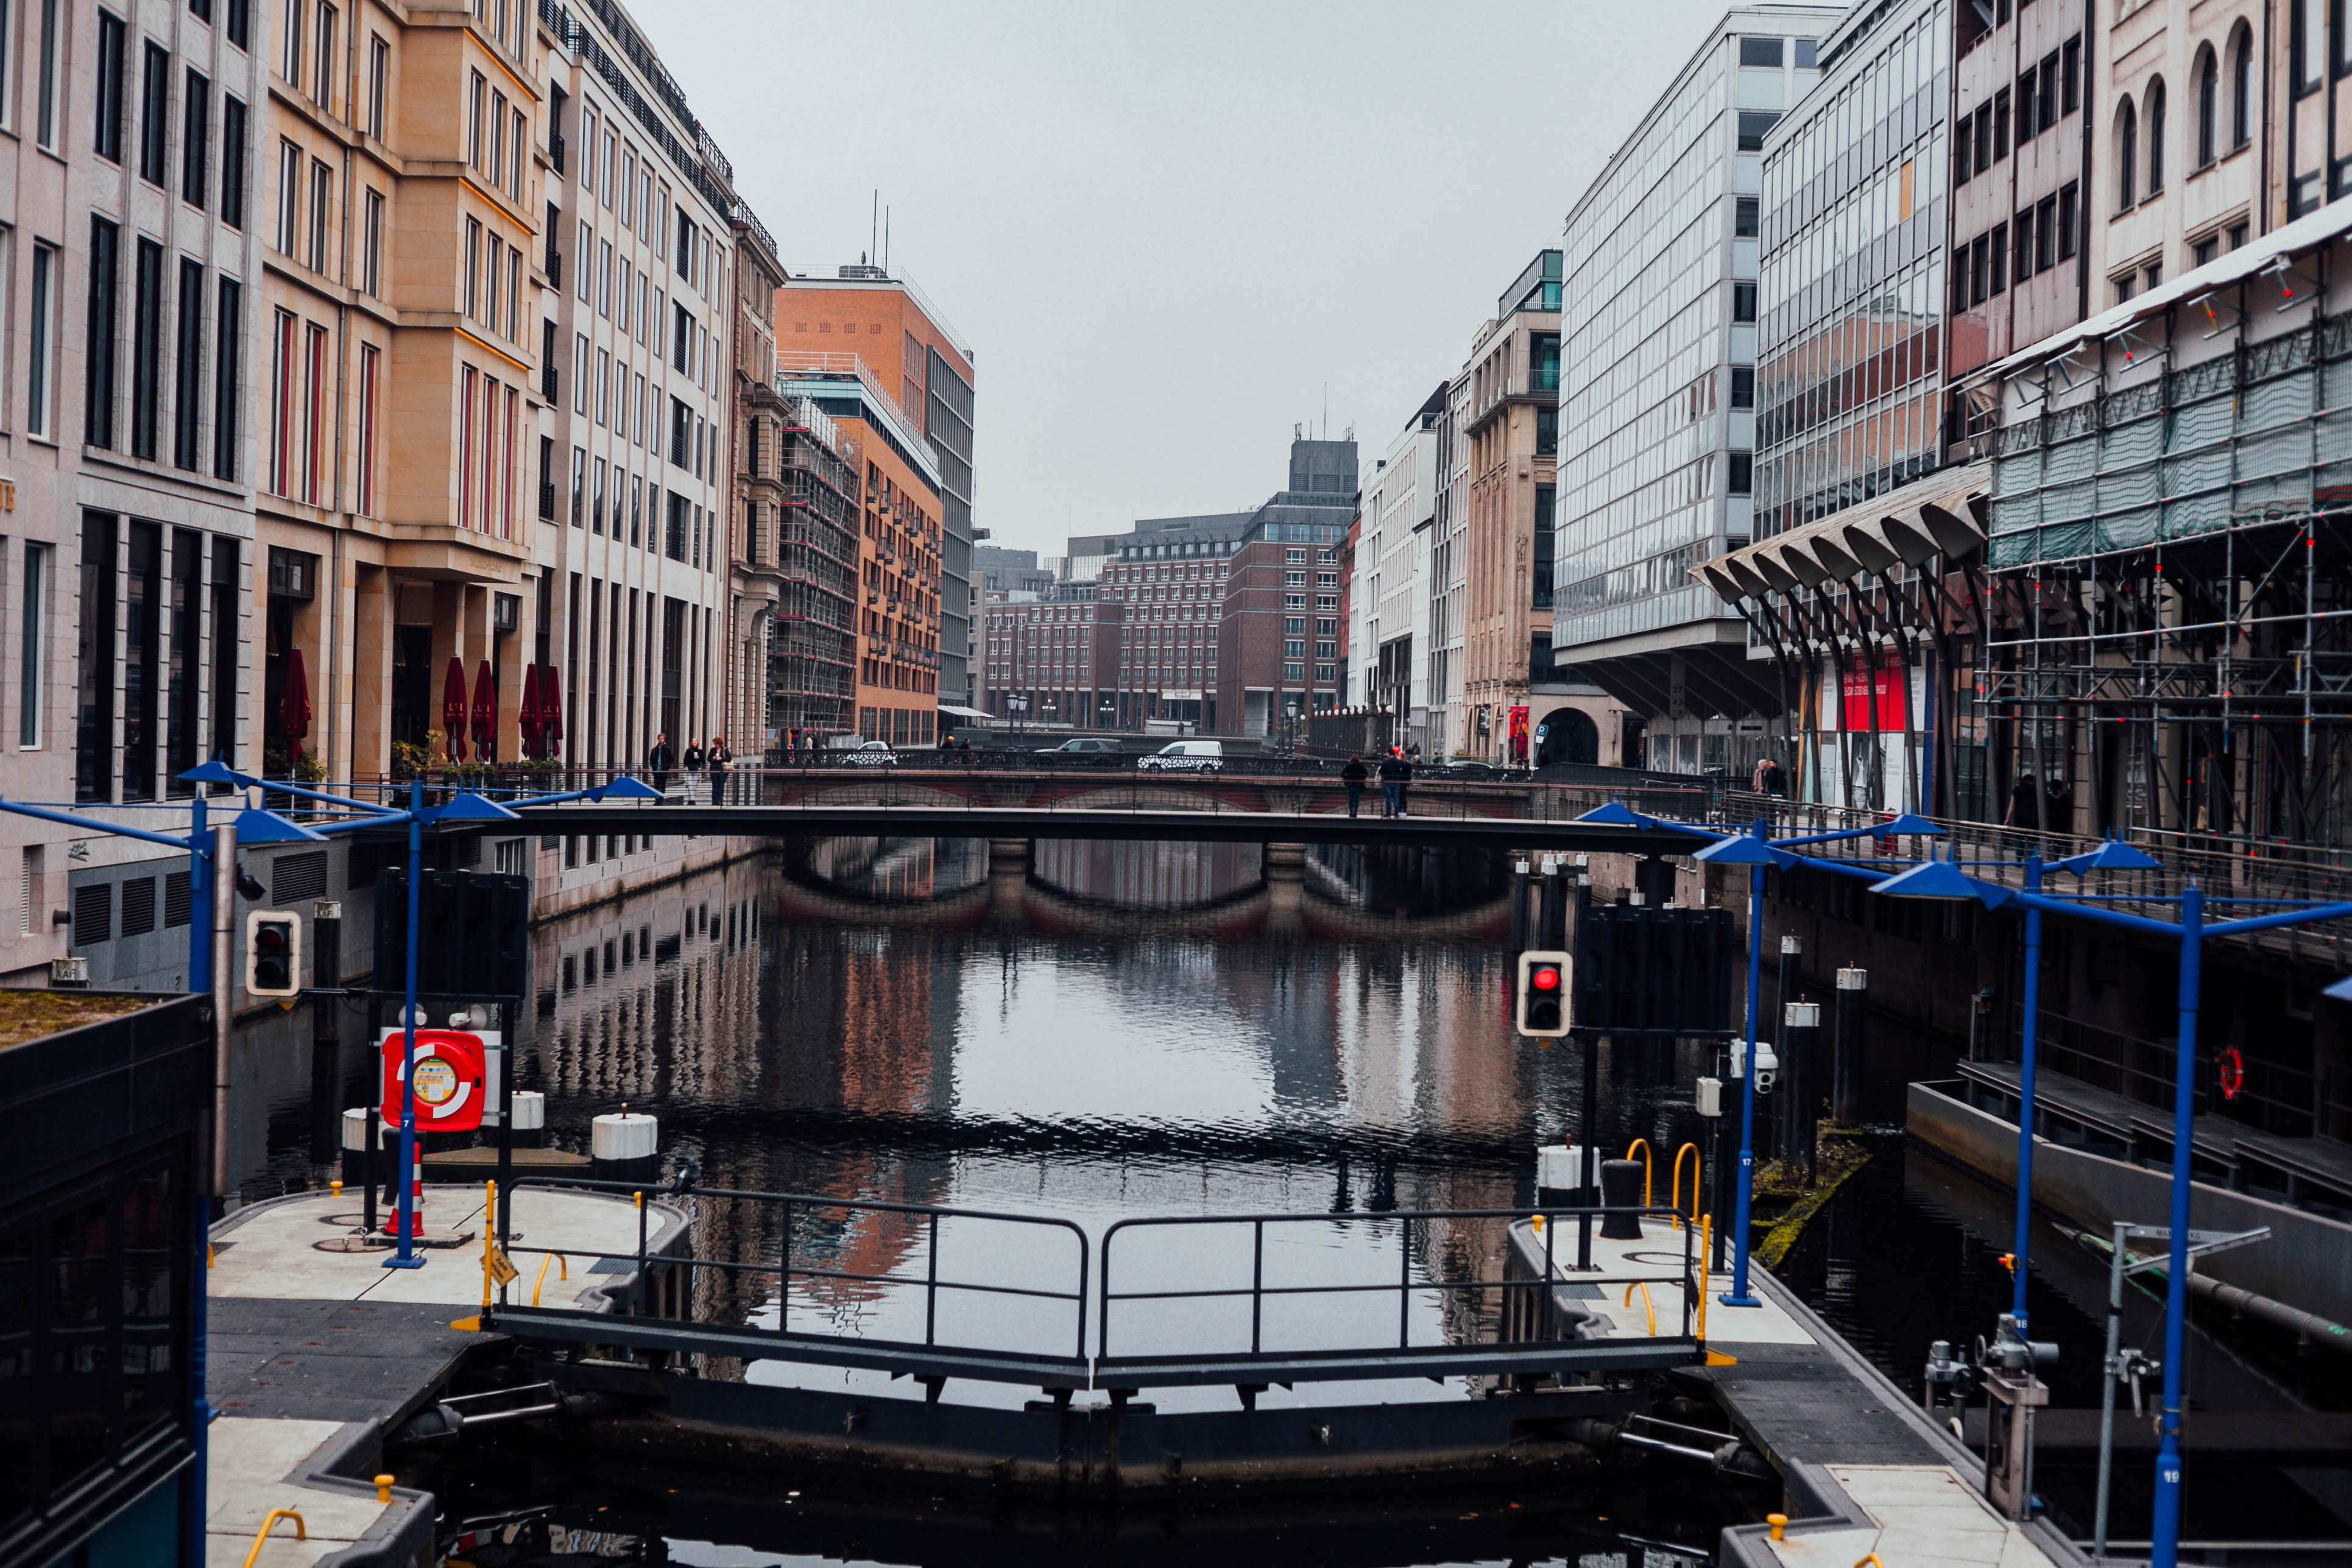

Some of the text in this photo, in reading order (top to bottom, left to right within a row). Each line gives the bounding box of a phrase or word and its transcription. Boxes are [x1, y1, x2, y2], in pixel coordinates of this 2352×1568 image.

[1538, 726, 1545, 735] P
[1742, 1158, 1751, 1167] 17
[2016, 1319, 2028, 1329] 18
[2163, 1469, 2180, 1483] 19
